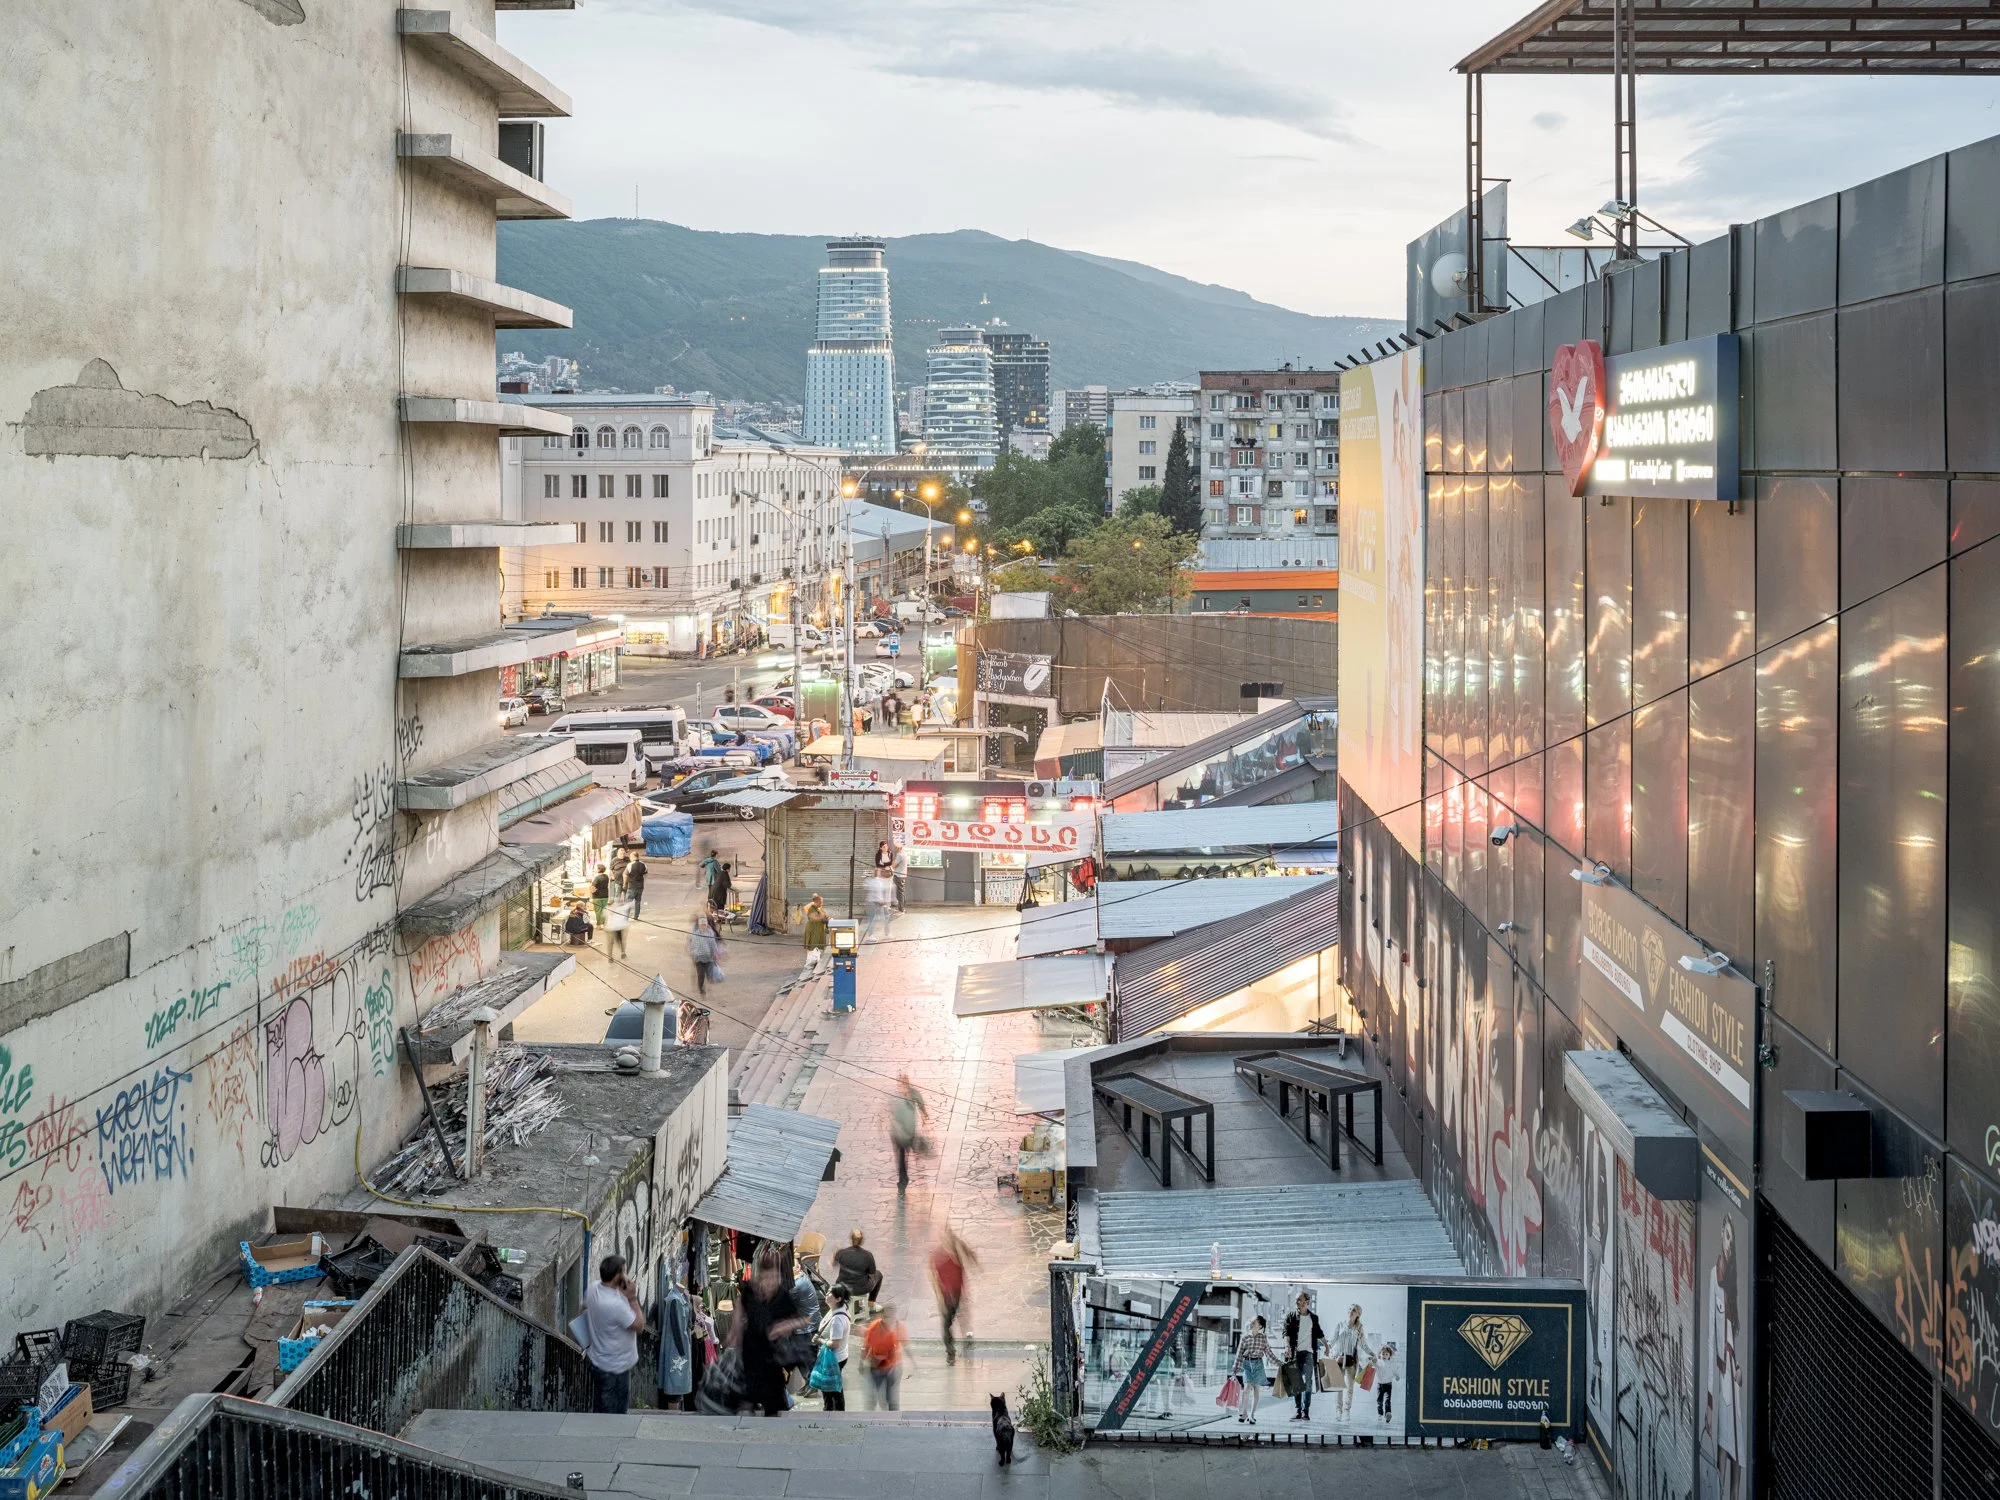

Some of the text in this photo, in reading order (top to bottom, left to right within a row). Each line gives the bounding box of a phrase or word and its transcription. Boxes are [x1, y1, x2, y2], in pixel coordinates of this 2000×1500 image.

[1669, 965, 1744, 1067] FASHION STYLE
[1687, 1034, 1722, 1077] CLOTHING SHOP
[1442, 1376, 1550, 1397] FASHION STYLE
[1442, 1398, 1503, 1410] ტანსაცმლის
